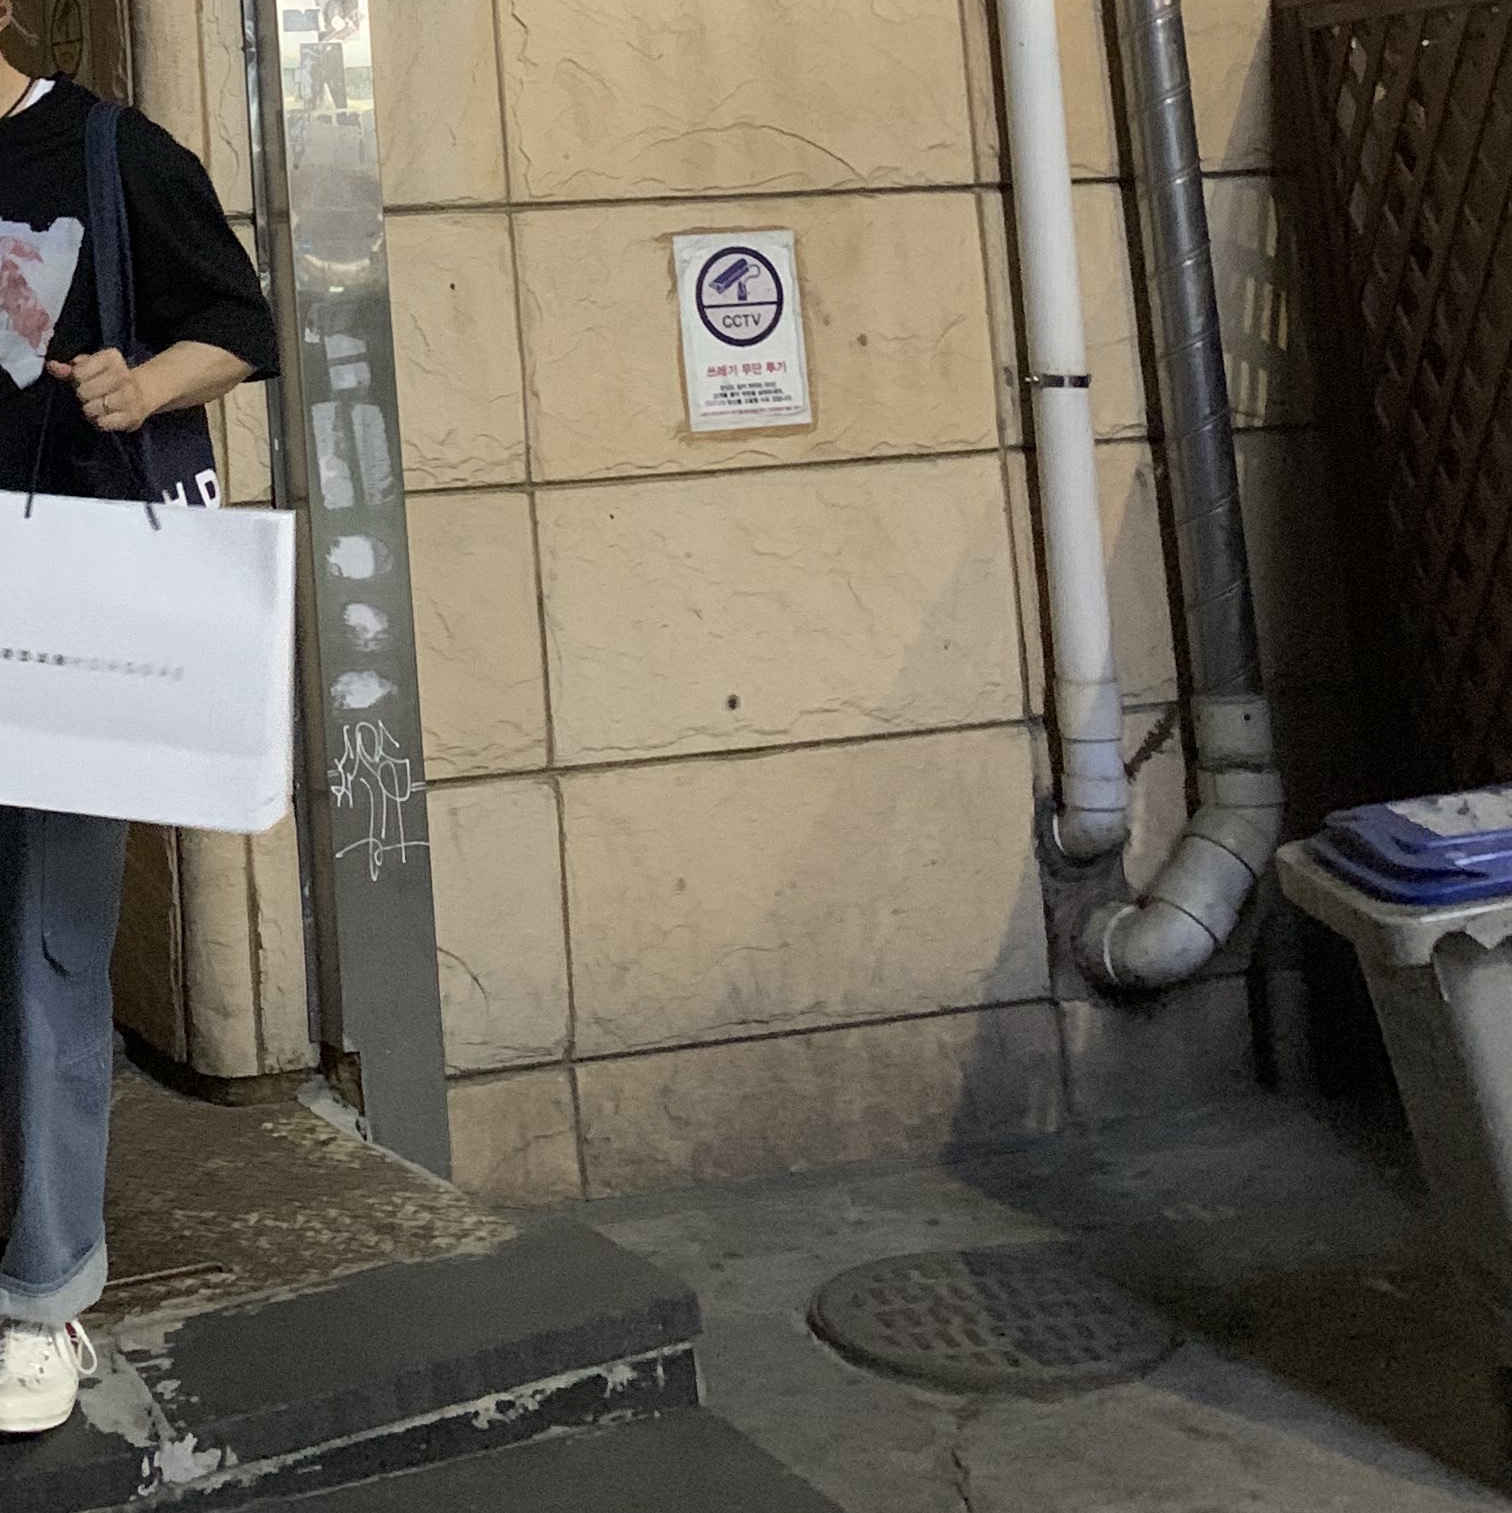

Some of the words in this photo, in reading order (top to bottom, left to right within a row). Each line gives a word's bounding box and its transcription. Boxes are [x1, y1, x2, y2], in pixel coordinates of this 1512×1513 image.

[722, 313, 761, 328] CCTV
[706, 364, 738, 377] 쓰레기
[766, 361, 787, 373] 투기
